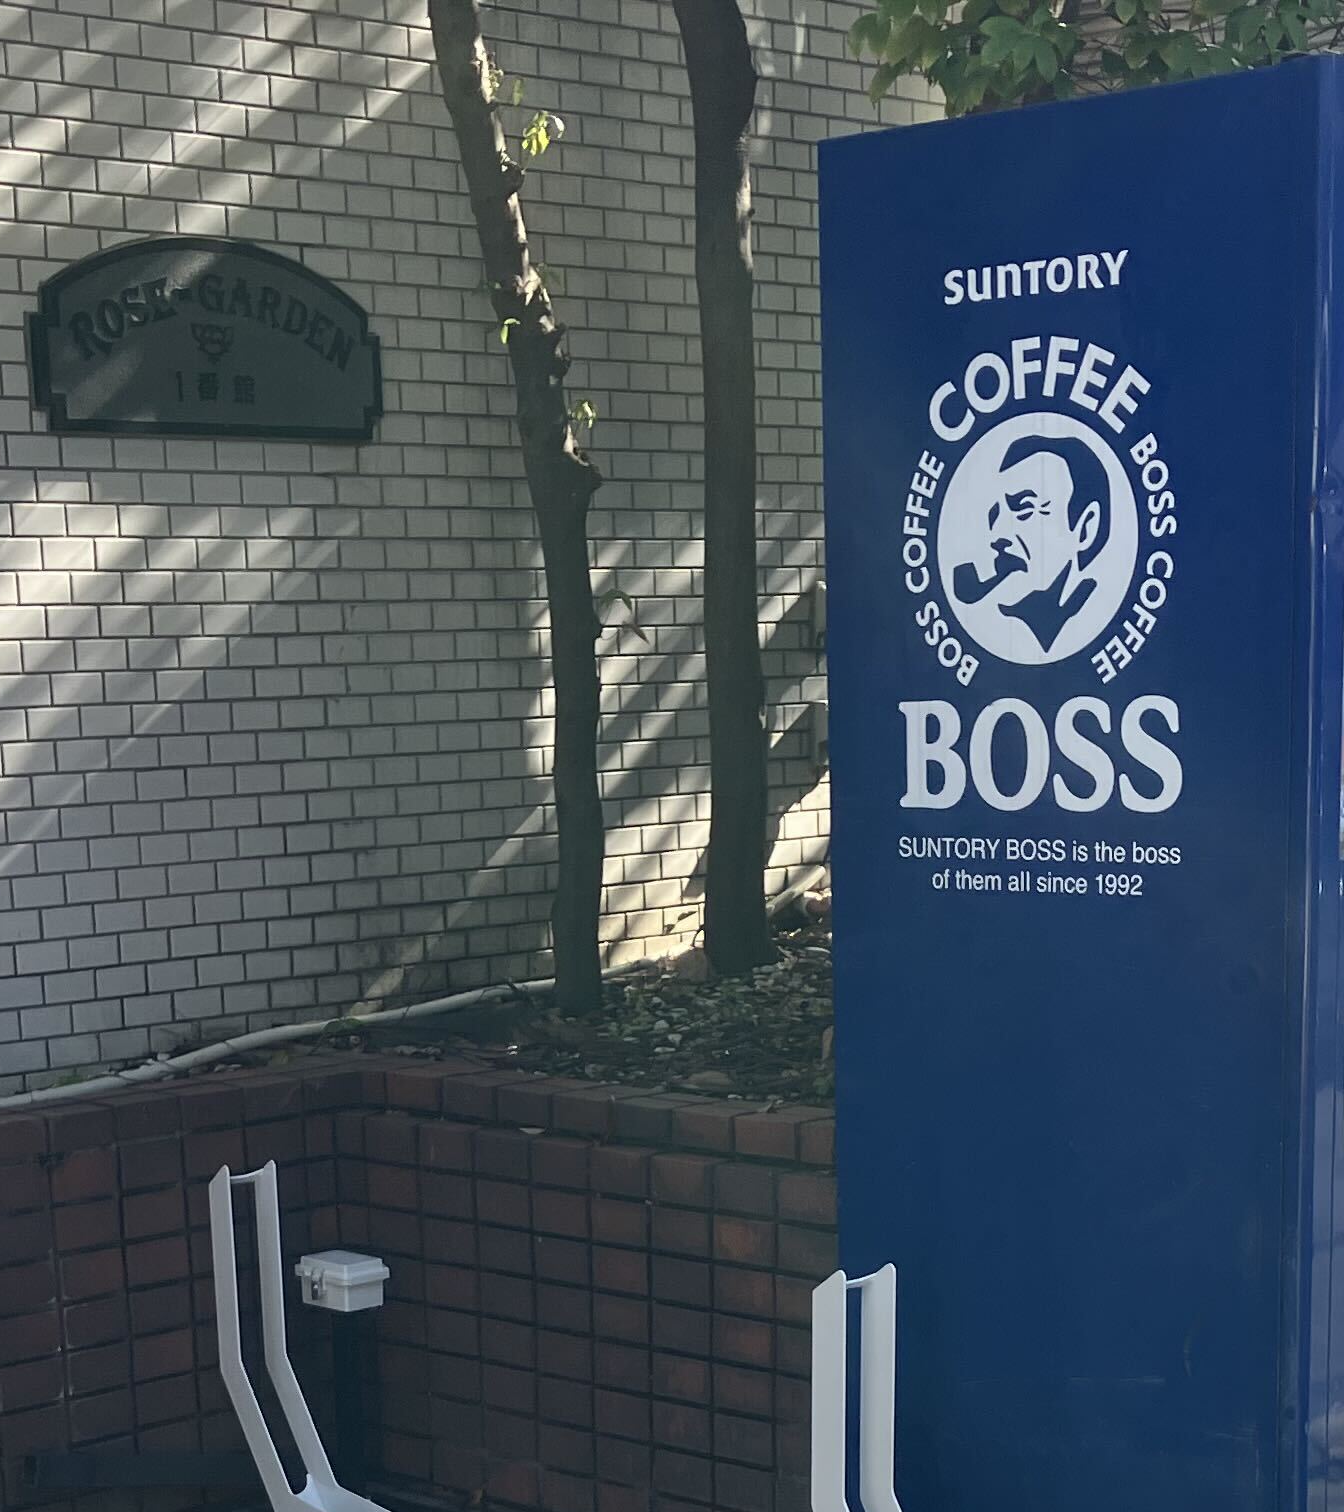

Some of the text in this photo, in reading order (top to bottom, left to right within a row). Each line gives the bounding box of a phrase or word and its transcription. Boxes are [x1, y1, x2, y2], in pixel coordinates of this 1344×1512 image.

[944, 249, 1128, 305] SUNTORY
[929, 335, 1152, 442] COFFEE
[902, 450, 980, 687] BOSS COFFEE
[1090, 432, 1177, 685] BOSS COFFEE
[898, 694, 1183, 813] BOSS
[898, 836, 1182, 865] SUNTORY BOSS is the boss
[931, 868, 1143, 896] of them all since 1992
